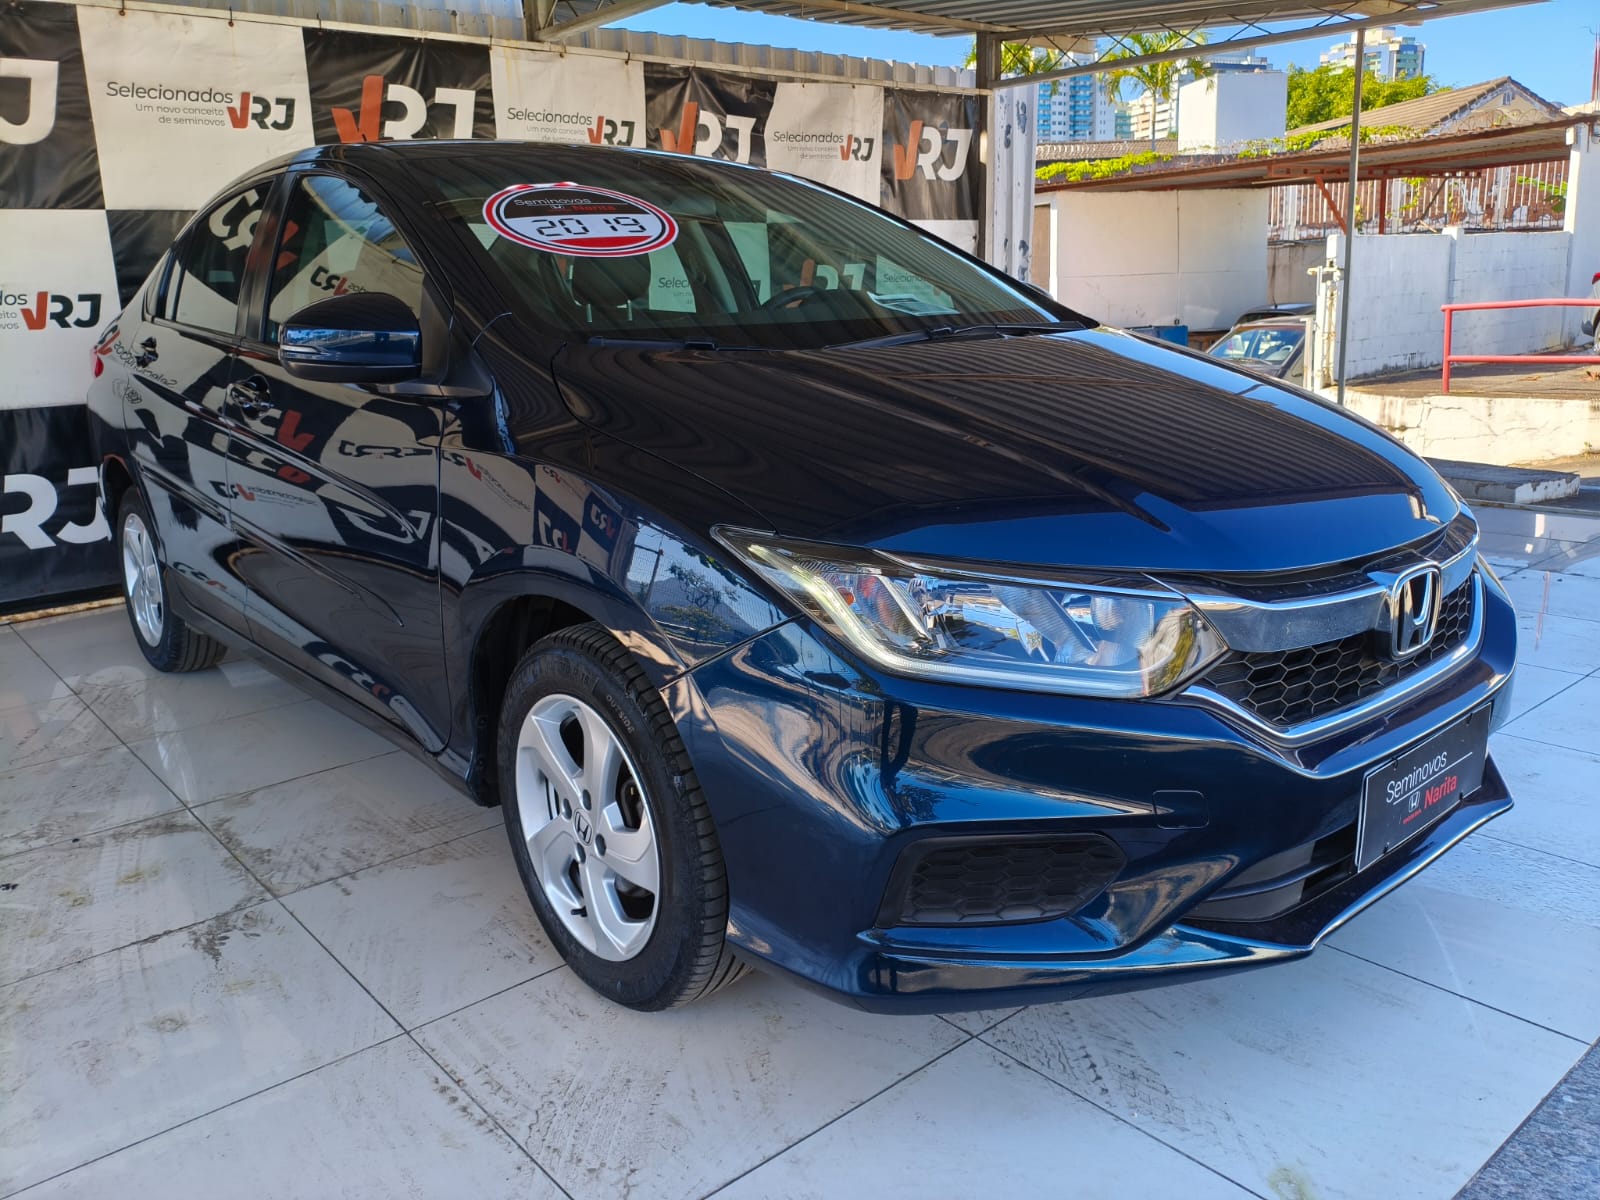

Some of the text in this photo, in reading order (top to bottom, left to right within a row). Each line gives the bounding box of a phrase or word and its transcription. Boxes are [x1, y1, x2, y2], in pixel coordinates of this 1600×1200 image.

[105, 81, 234, 104] Selecionados
[135, 103, 154, 112] Um
[156, 105, 181, 114] novo
[158, 116, 226, 127] de seminovos
[226, 91, 296, 131] VRJ
[506, 107, 593, 126] Selecionados
[587, 115, 636, 146] VRJ
[773, 129, 845, 144] Selecionados
[840, 133, 875, 162] VRJ
[893, 120, 973, 182] VRJ
[20, 291, 102, 331] VRJ
[1385, 751, 1448, 804] Seminovos
[1423, 775, 1458, 809] Narita
